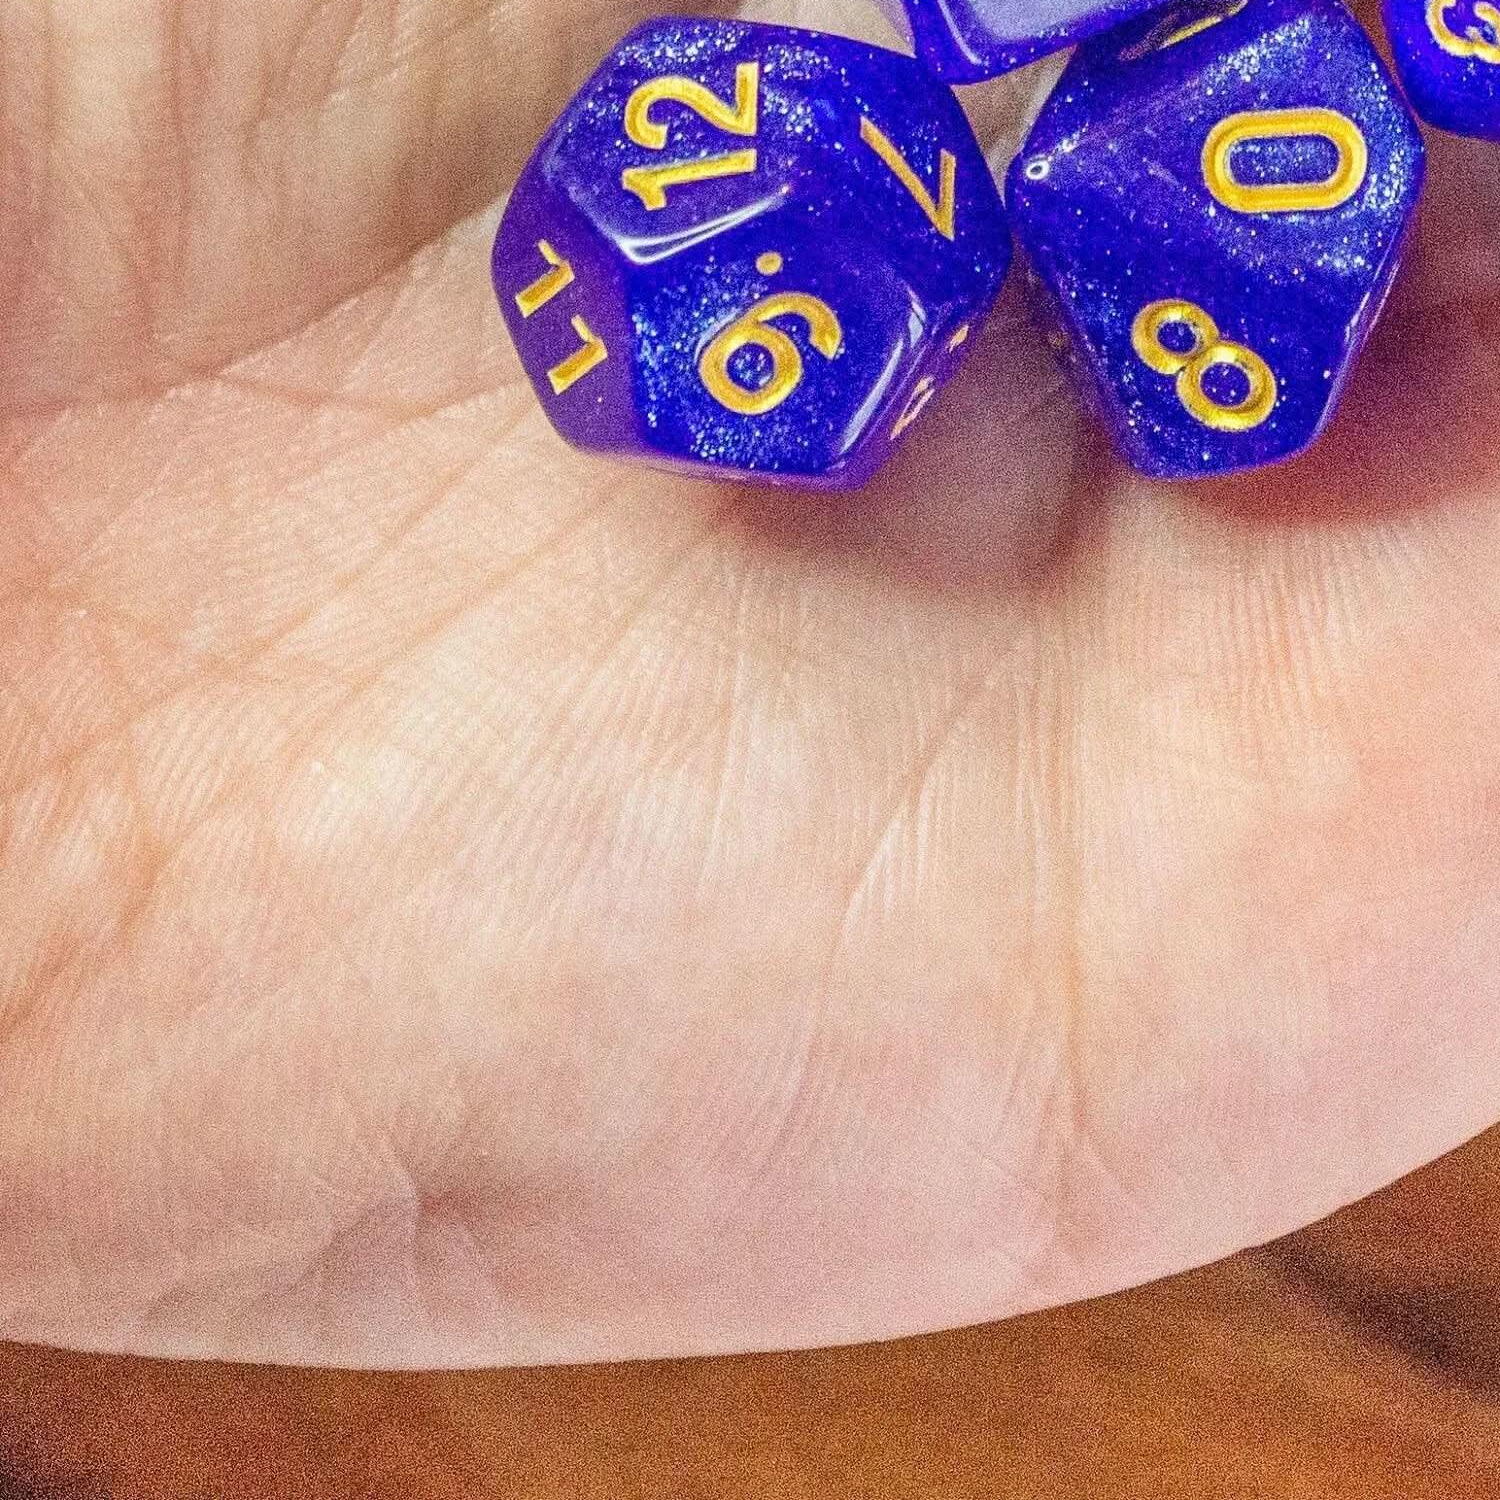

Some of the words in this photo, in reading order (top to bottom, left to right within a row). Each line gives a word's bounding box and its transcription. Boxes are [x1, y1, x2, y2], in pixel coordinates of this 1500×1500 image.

[621, 61, 760, 211] 12
[860, 116, 956, 241] 7
[1201, 107, 1369, 214] 0
[514, 239, 608, 395] 11
[1131, 299, 1278, 433] 8
